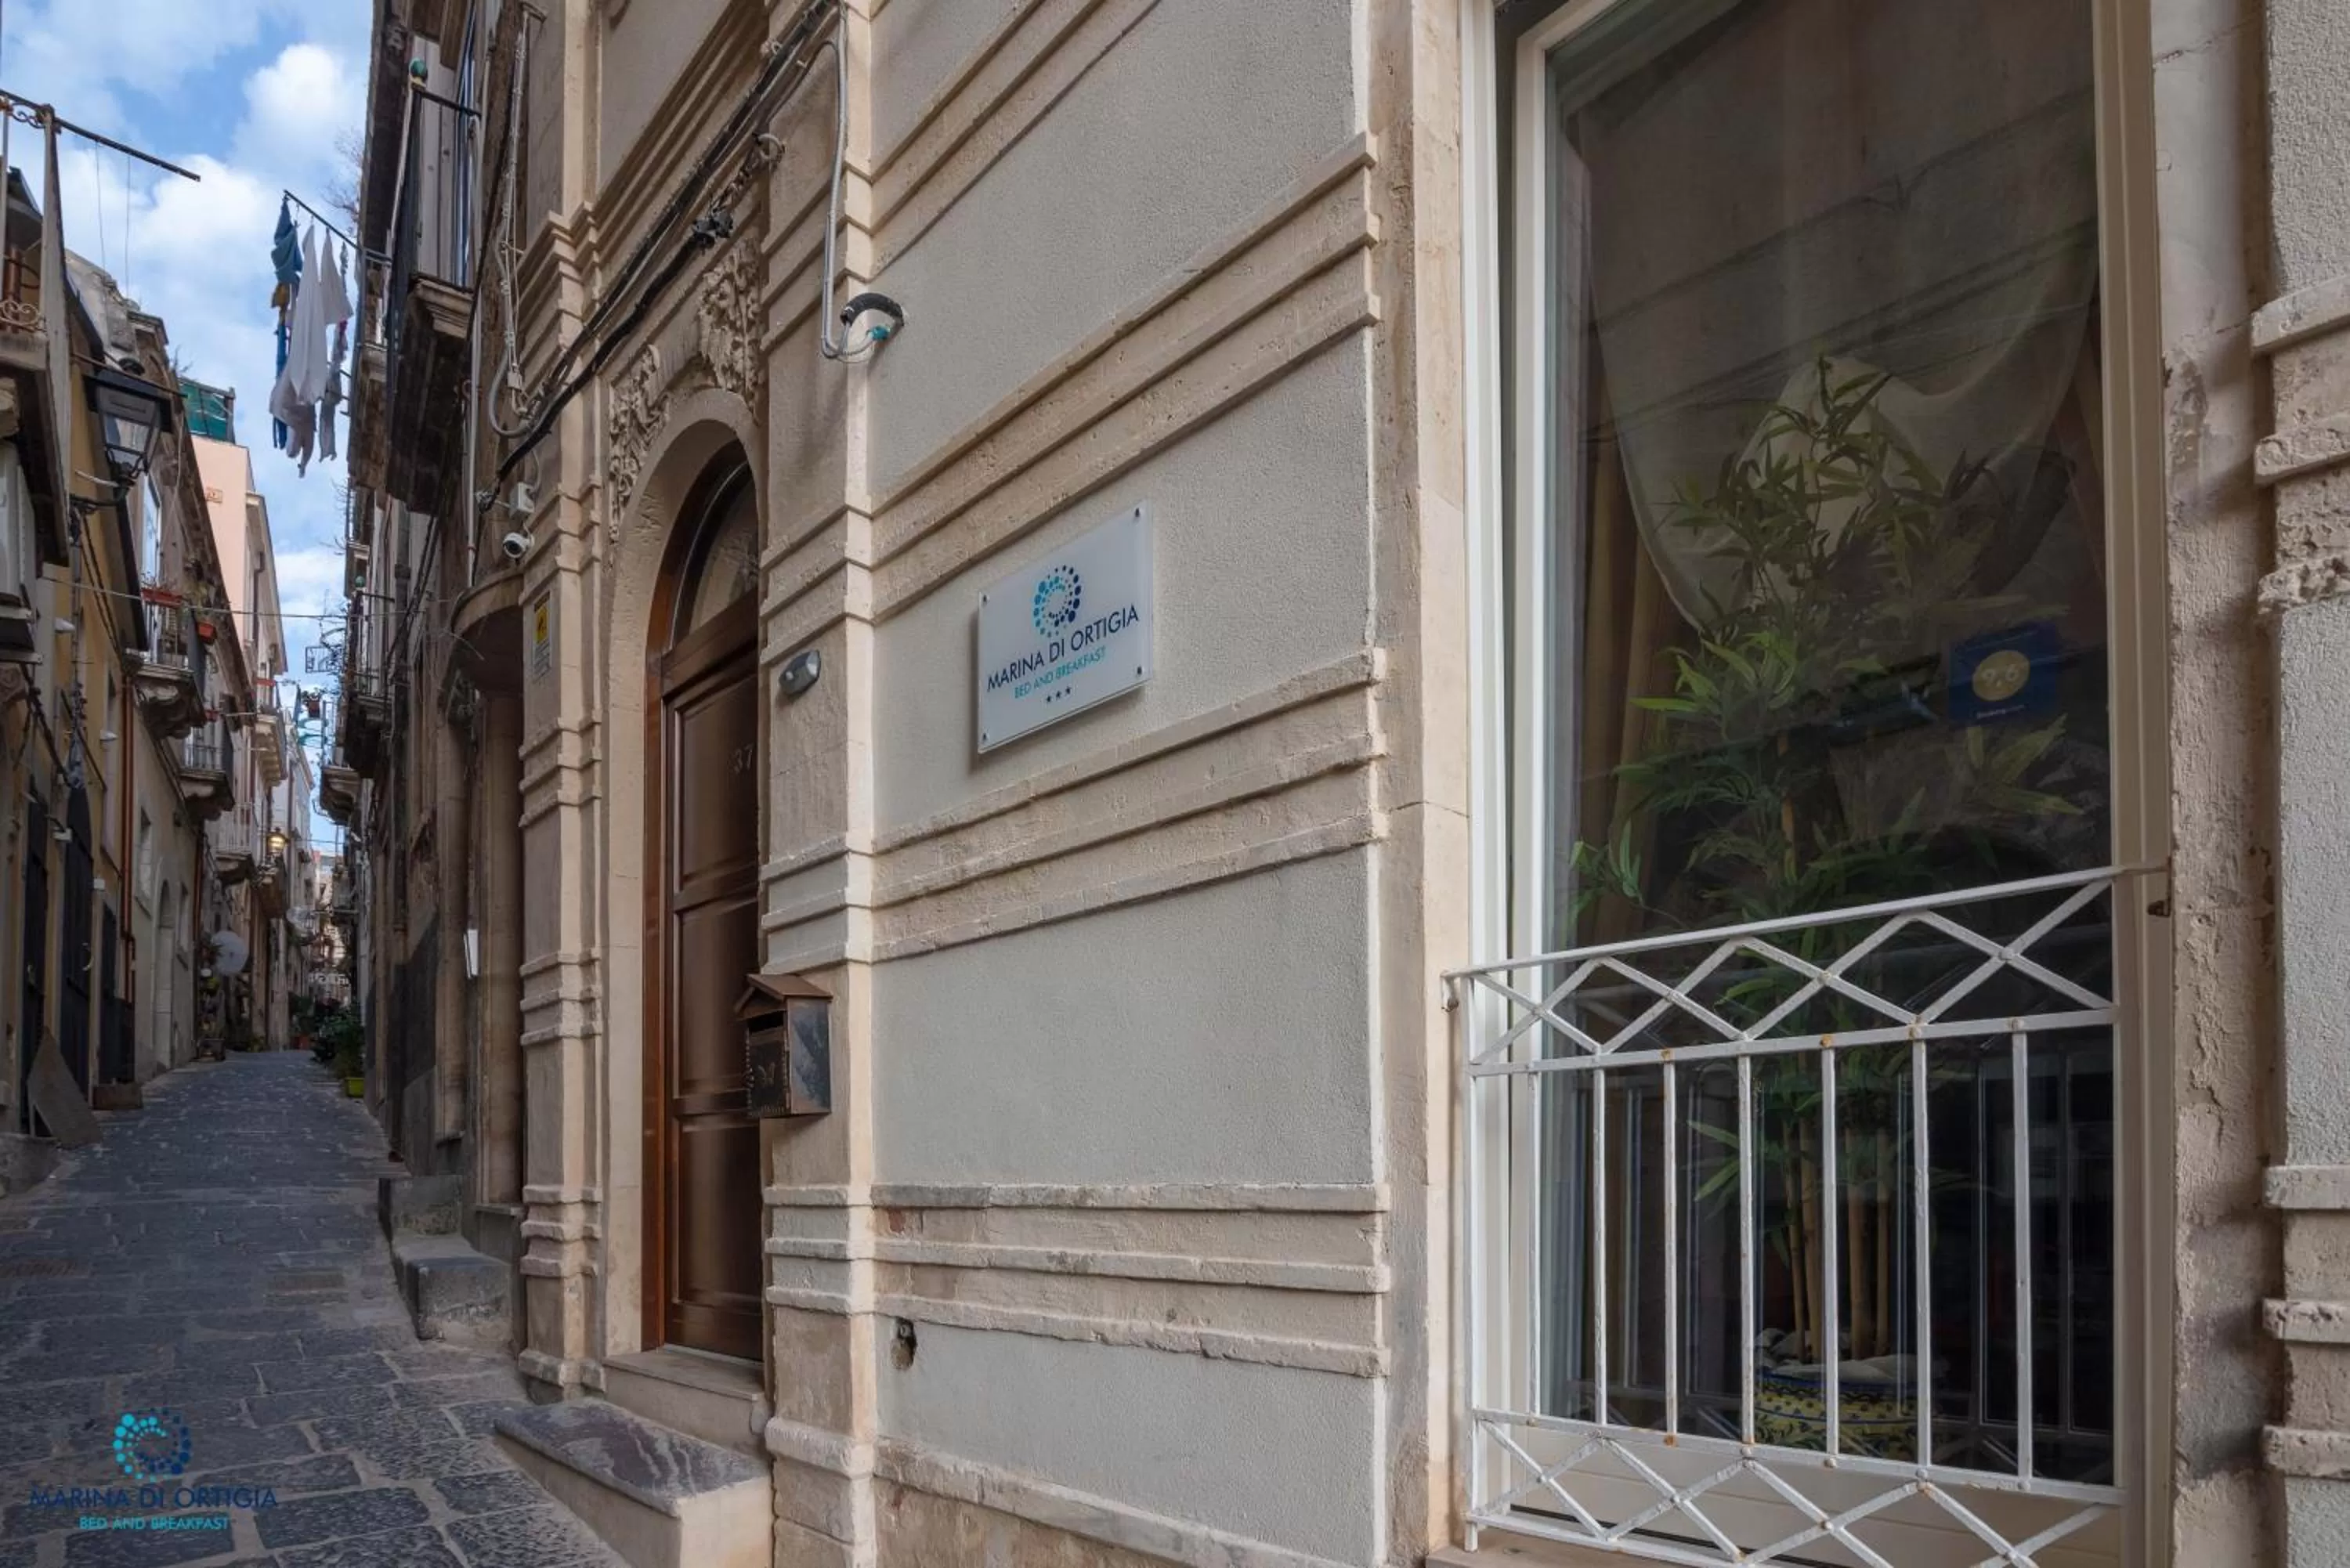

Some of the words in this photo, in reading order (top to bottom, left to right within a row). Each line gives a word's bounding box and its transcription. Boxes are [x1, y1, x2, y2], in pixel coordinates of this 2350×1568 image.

[987, 651, 1044, 692] MARINA
[1049, 638, 1065, 663] DI
[1071, 604, 1139, 652] ORTIGIA
[1014, 681, 1032, 699] BED
[1034, 672, 1054, 689] AND
[1055, 645, 1106, 678] BREAKFAST
